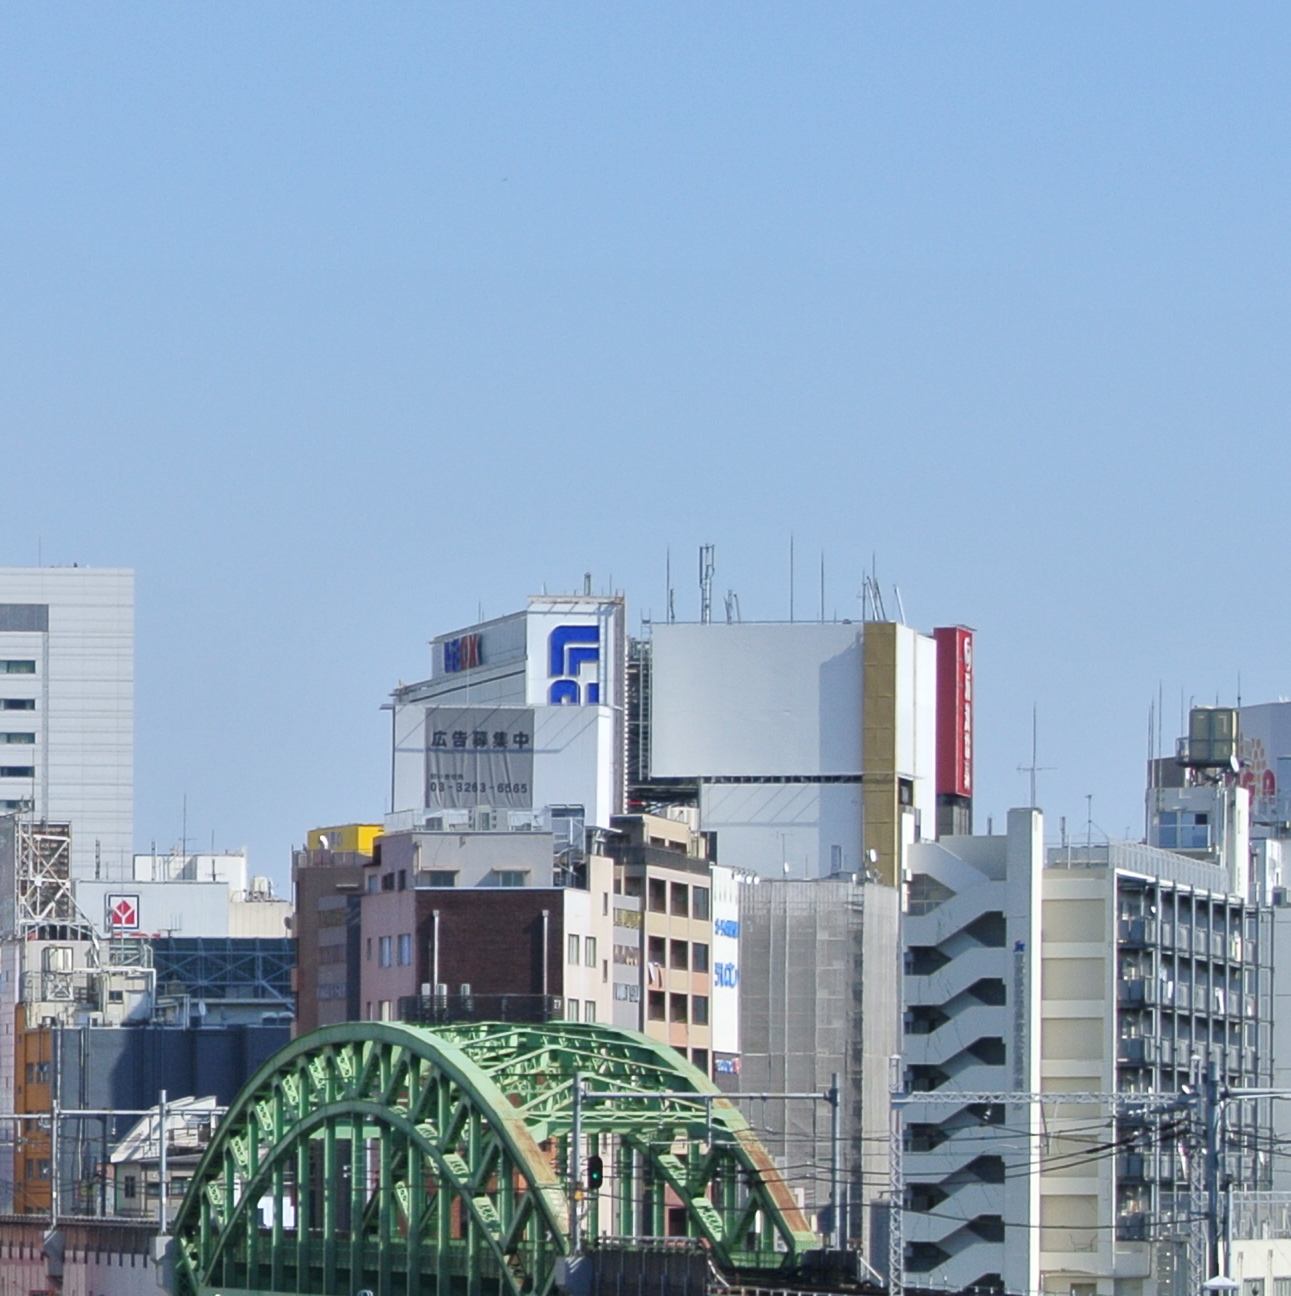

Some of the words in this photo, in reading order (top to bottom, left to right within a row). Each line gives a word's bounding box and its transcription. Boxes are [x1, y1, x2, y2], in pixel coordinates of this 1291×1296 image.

[431, 730, 529, 749] 広告募集中
